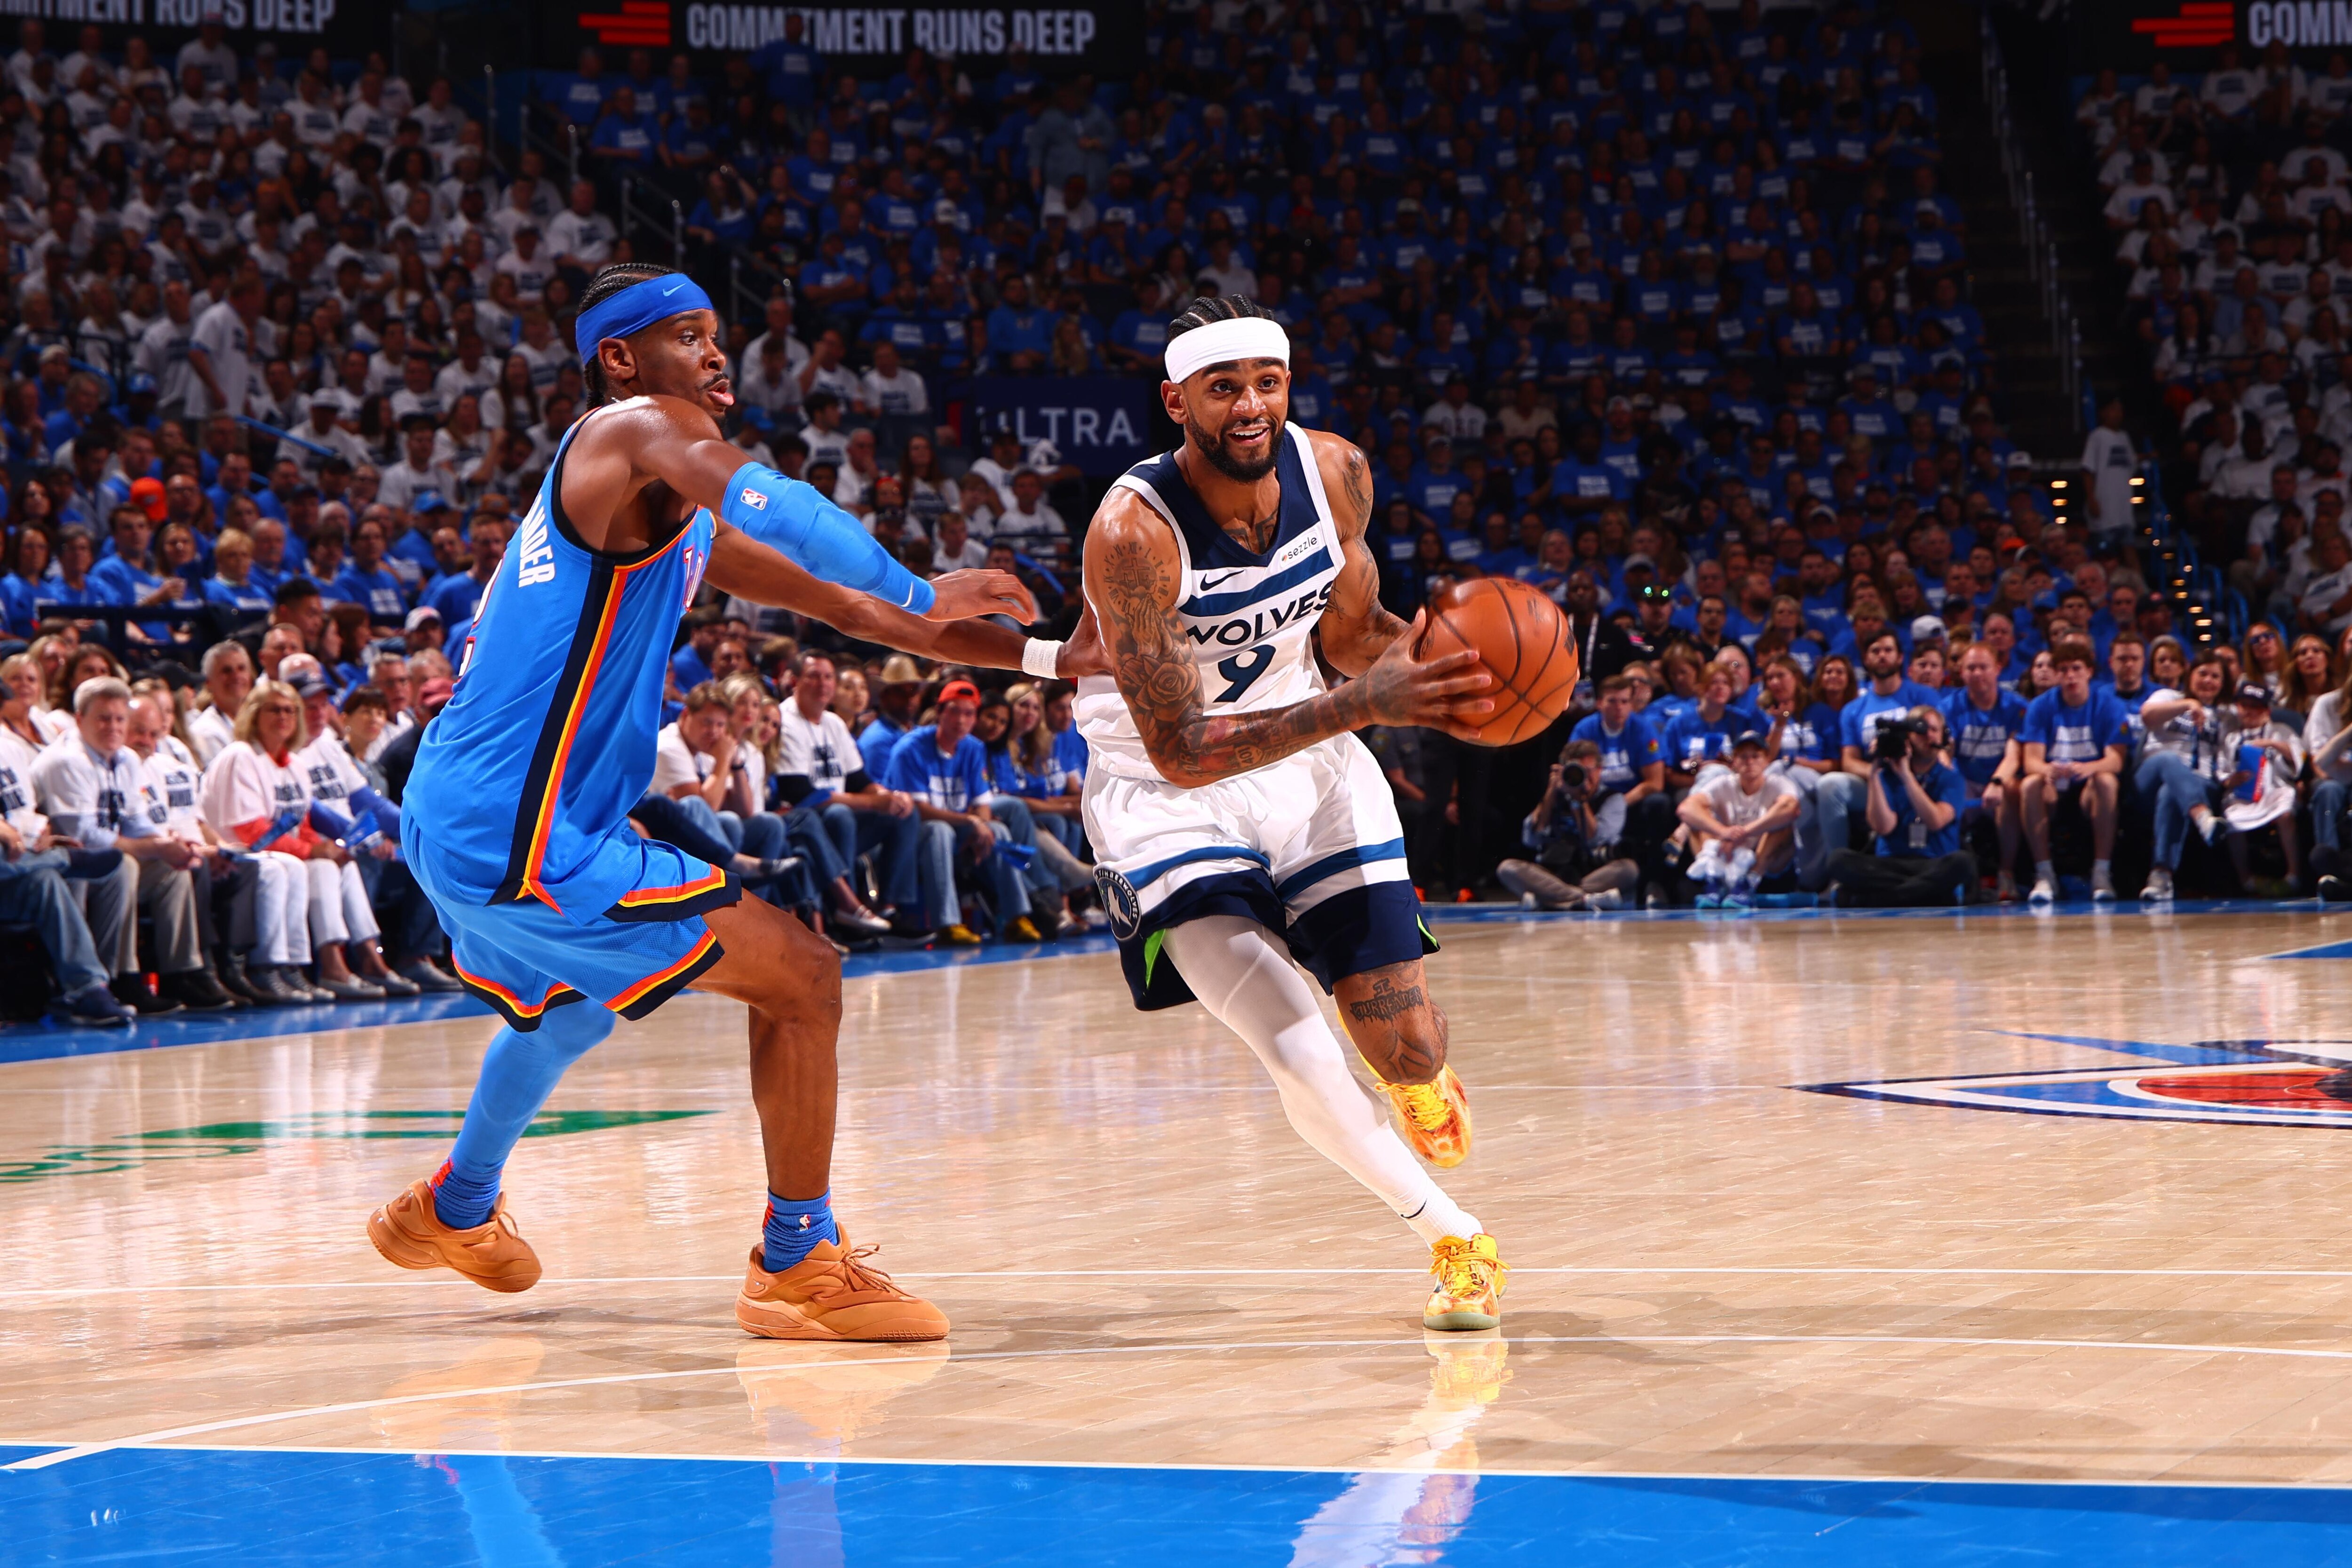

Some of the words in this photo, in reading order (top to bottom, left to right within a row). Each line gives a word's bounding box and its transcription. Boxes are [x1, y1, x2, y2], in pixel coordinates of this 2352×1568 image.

[253, 0, 336, 33] DEEP
[686, 2, 907, 55] COMMTMENT
[913, 8, 1006, 56] RUNS
[1011, 8, 1097, 56] DEEP
[1288, 537, 1317, 559] sezzle
[1213, 644, 1276, 703] 9
[1098, 869, 1138, 919] TIMBERWOLVES
